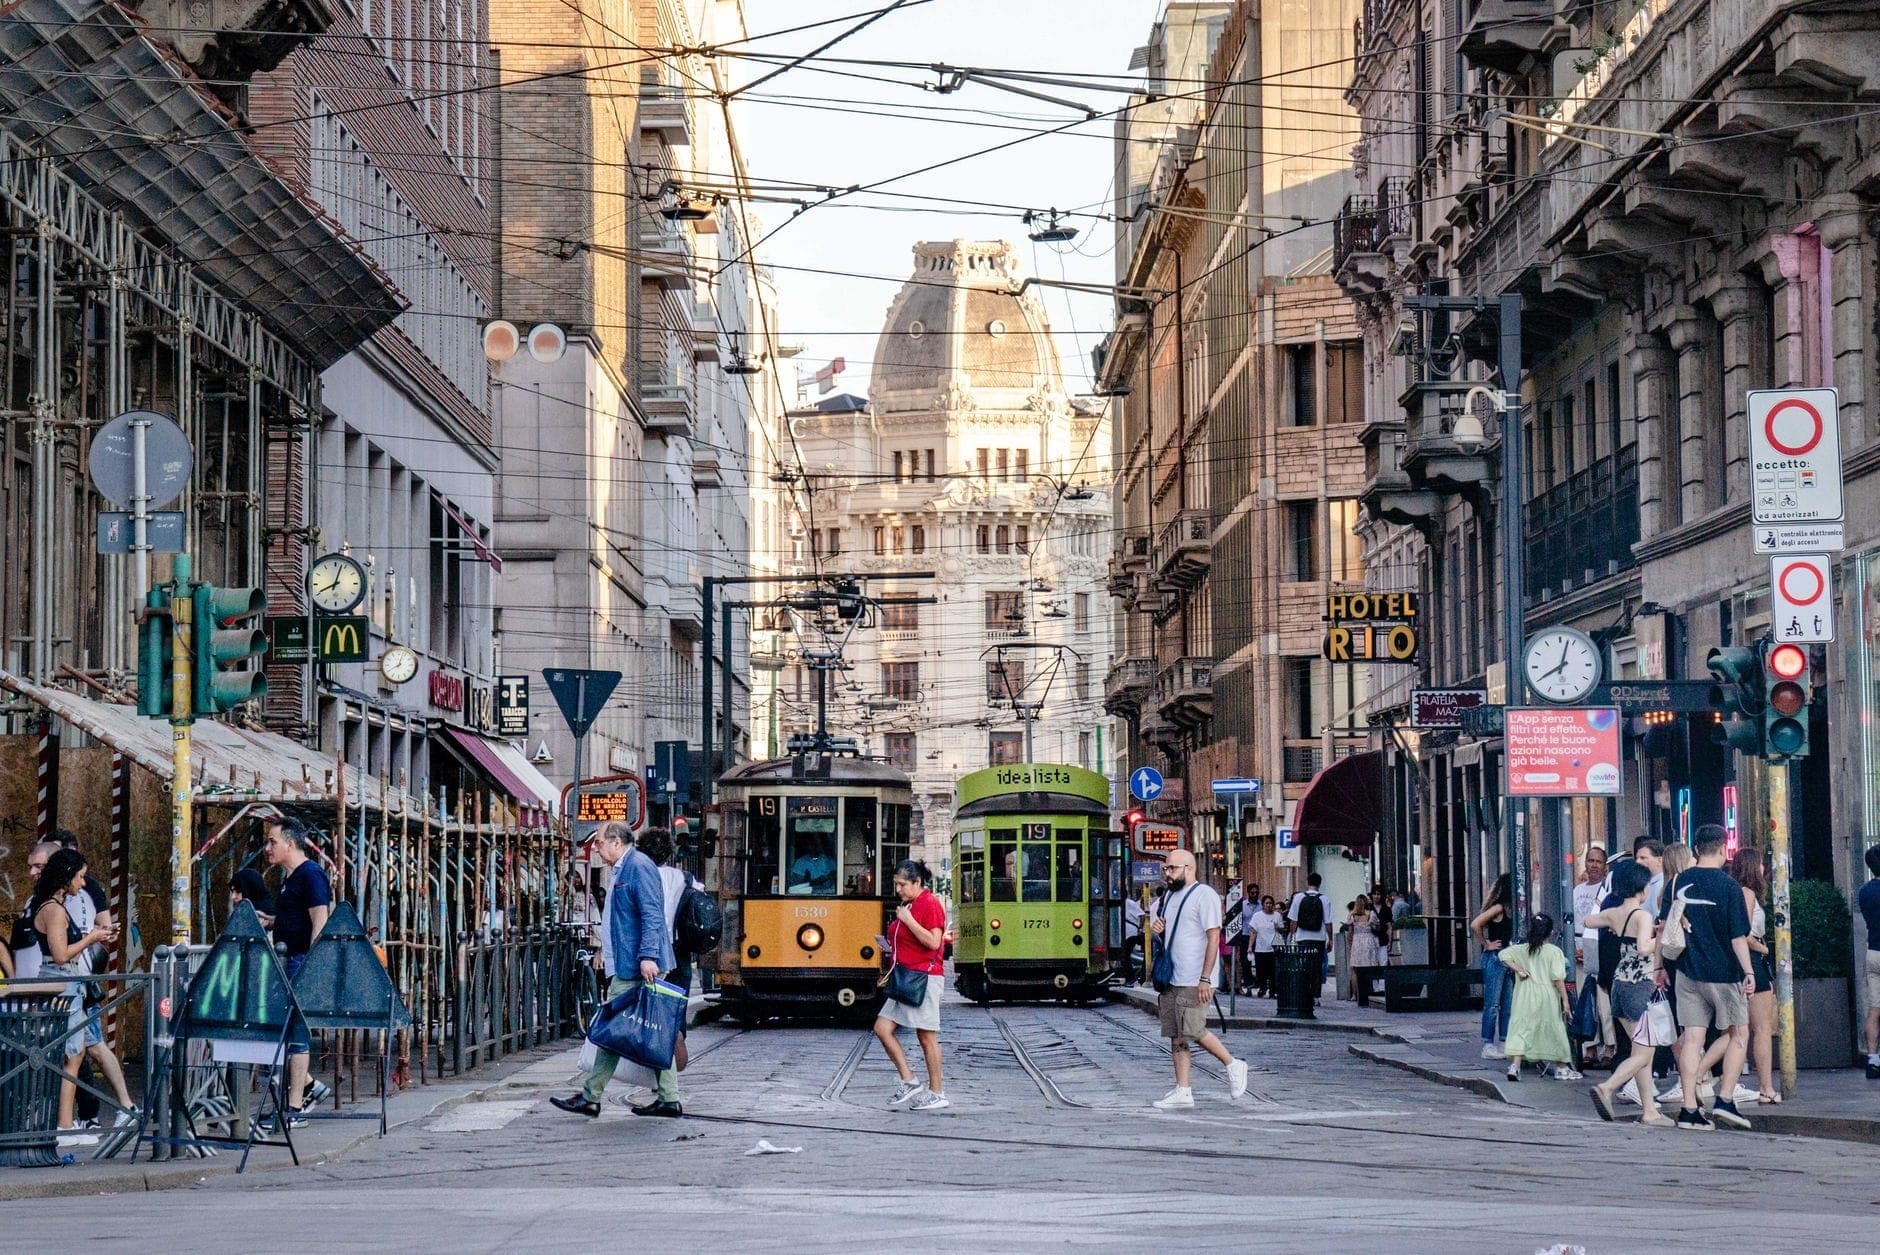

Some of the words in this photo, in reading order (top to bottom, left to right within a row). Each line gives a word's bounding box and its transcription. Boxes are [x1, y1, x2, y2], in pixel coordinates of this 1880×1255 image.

[1756, 459, 1811, 470] eccetto:
[1772, 511, 1819, 519] autorizzati
[1329, 592, 1416, 619] HOTEL
[1329, 624, 1415, 660] RIO
[1420, 695, 1458, 706] FILATELIA
[1509, 714, 1539, 725] L'App
[1541, 716, 1574, 724] senza
[1510, 724, 1530, 734] filtri
[1532, 724, 1547, 734] ad
[1549, 724, 1586, 734] effetto.
[1550, 735, 1560, 744] le
[1561, 735, 1597, 744] buone
[1510, 746, 1542, 755] azioni
[1544, 747, 1592, 755] nascono
[1529, 756, 1559, 765] belle.
[997, 768, 1071, 785] idealista
[759, 797, 776, 817] 19
[1027, 824, 1046, 840] 19
[1023, 920, 1050, 929] 1773
